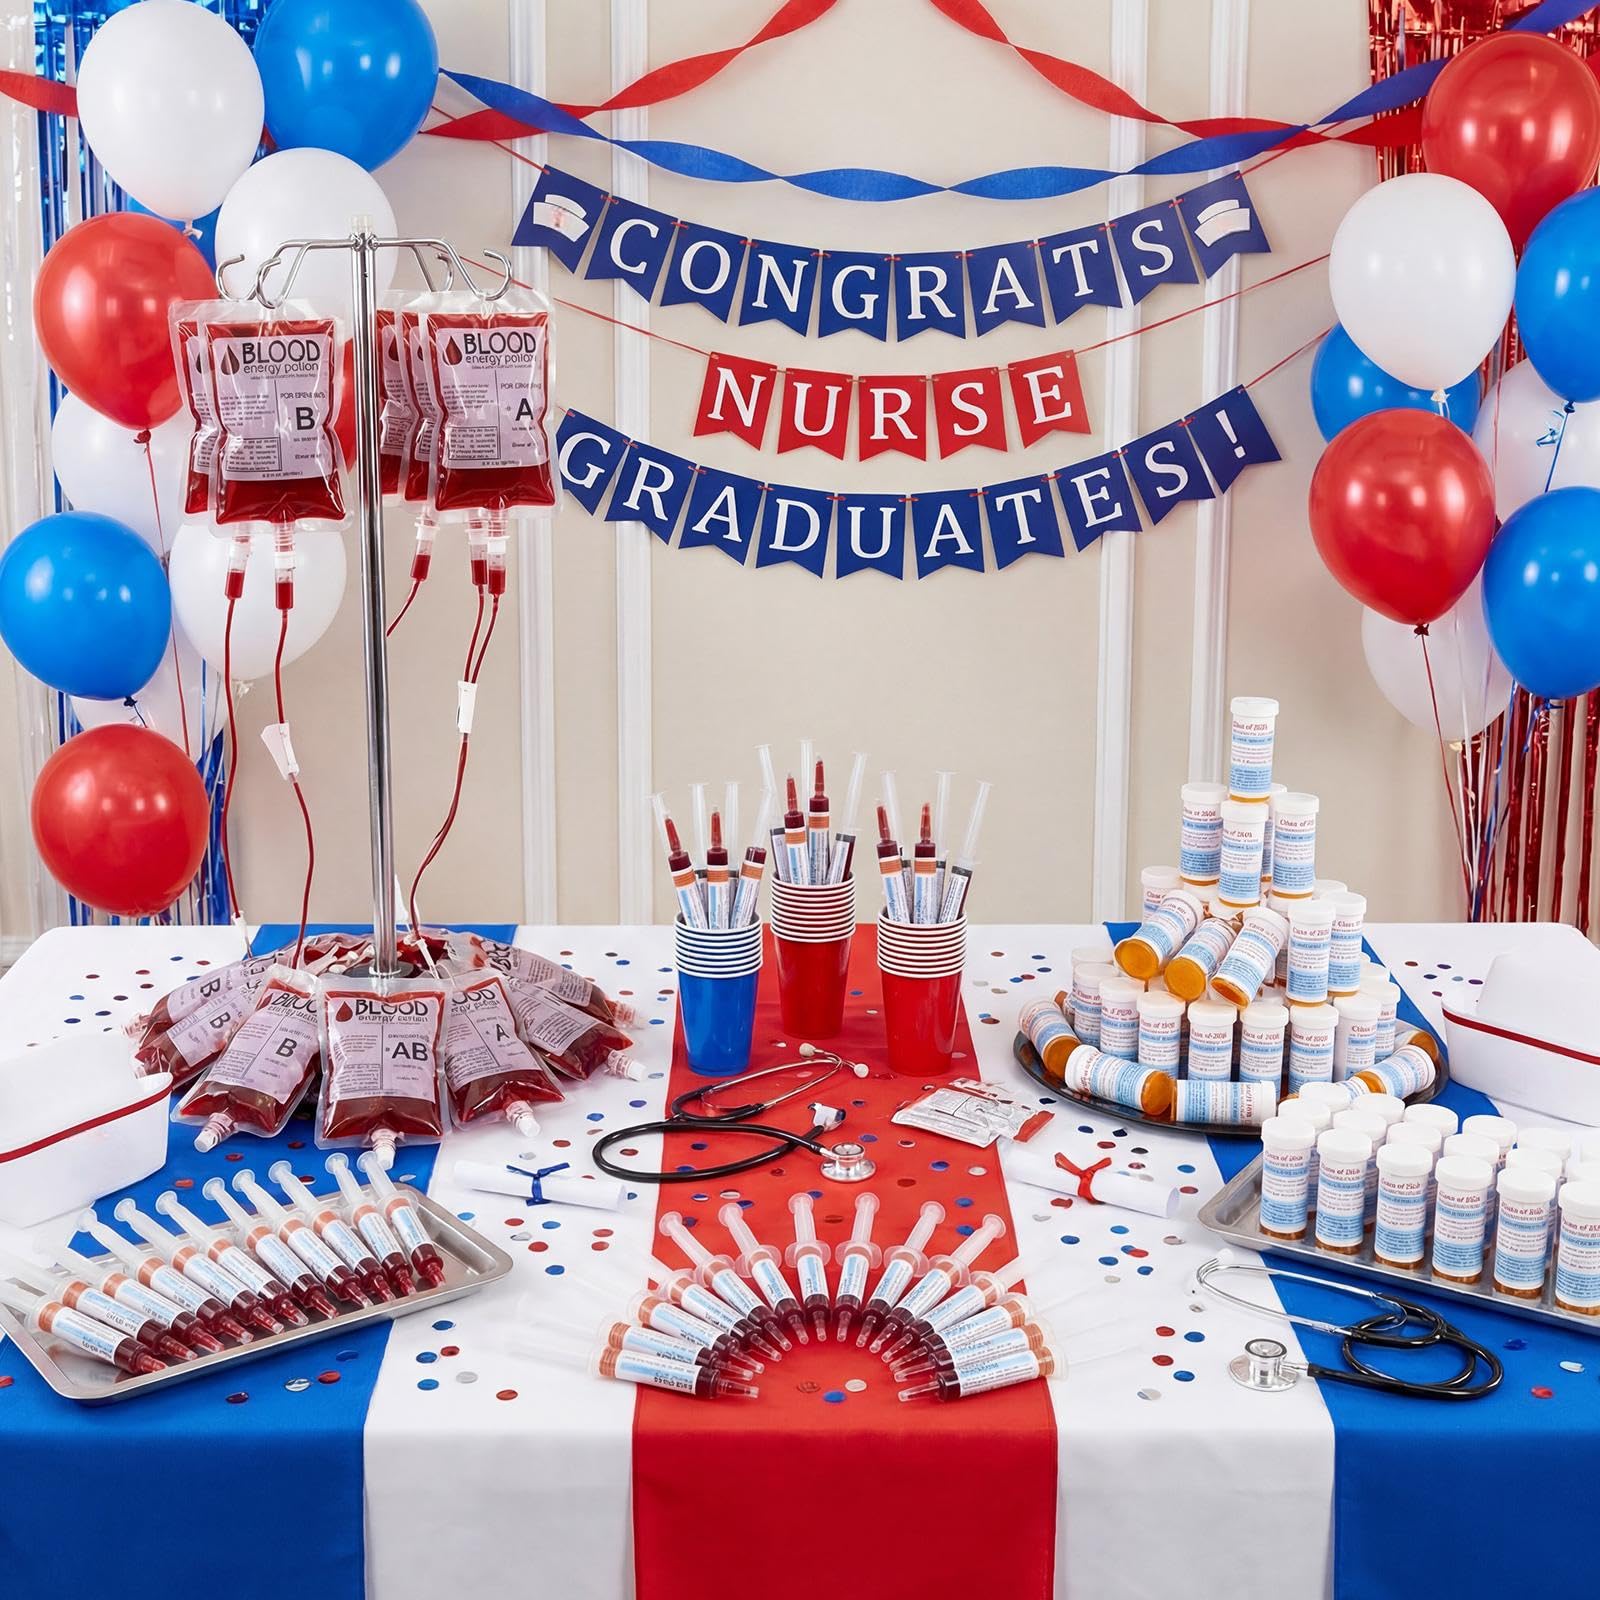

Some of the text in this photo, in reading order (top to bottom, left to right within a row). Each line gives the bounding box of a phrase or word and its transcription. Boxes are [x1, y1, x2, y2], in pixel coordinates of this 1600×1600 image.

[608, 215, 1178, 321] CONGRATS
[242, 339, 321, 364] BLOOD
[464, 331, 537, 355] BLOOD
[243, 363, 281, 376] energy
[465, 353, 502, 366] energy
[515, 397, 534, 422] A
[707, 364, 1075, 442] NURSE
[295, 406, 316, 431] B
[559, 410, 1249, 562] GRADUATES!
[200, 977, 221, 998] B
[355, 998, 429, 1017] BLOOD
[209, 1011, 231, 1029] B
[496, 1023, 511, 1042] A
[275, 1037, 297, 1058] B
[391, 1041, 428, 1062] AB
